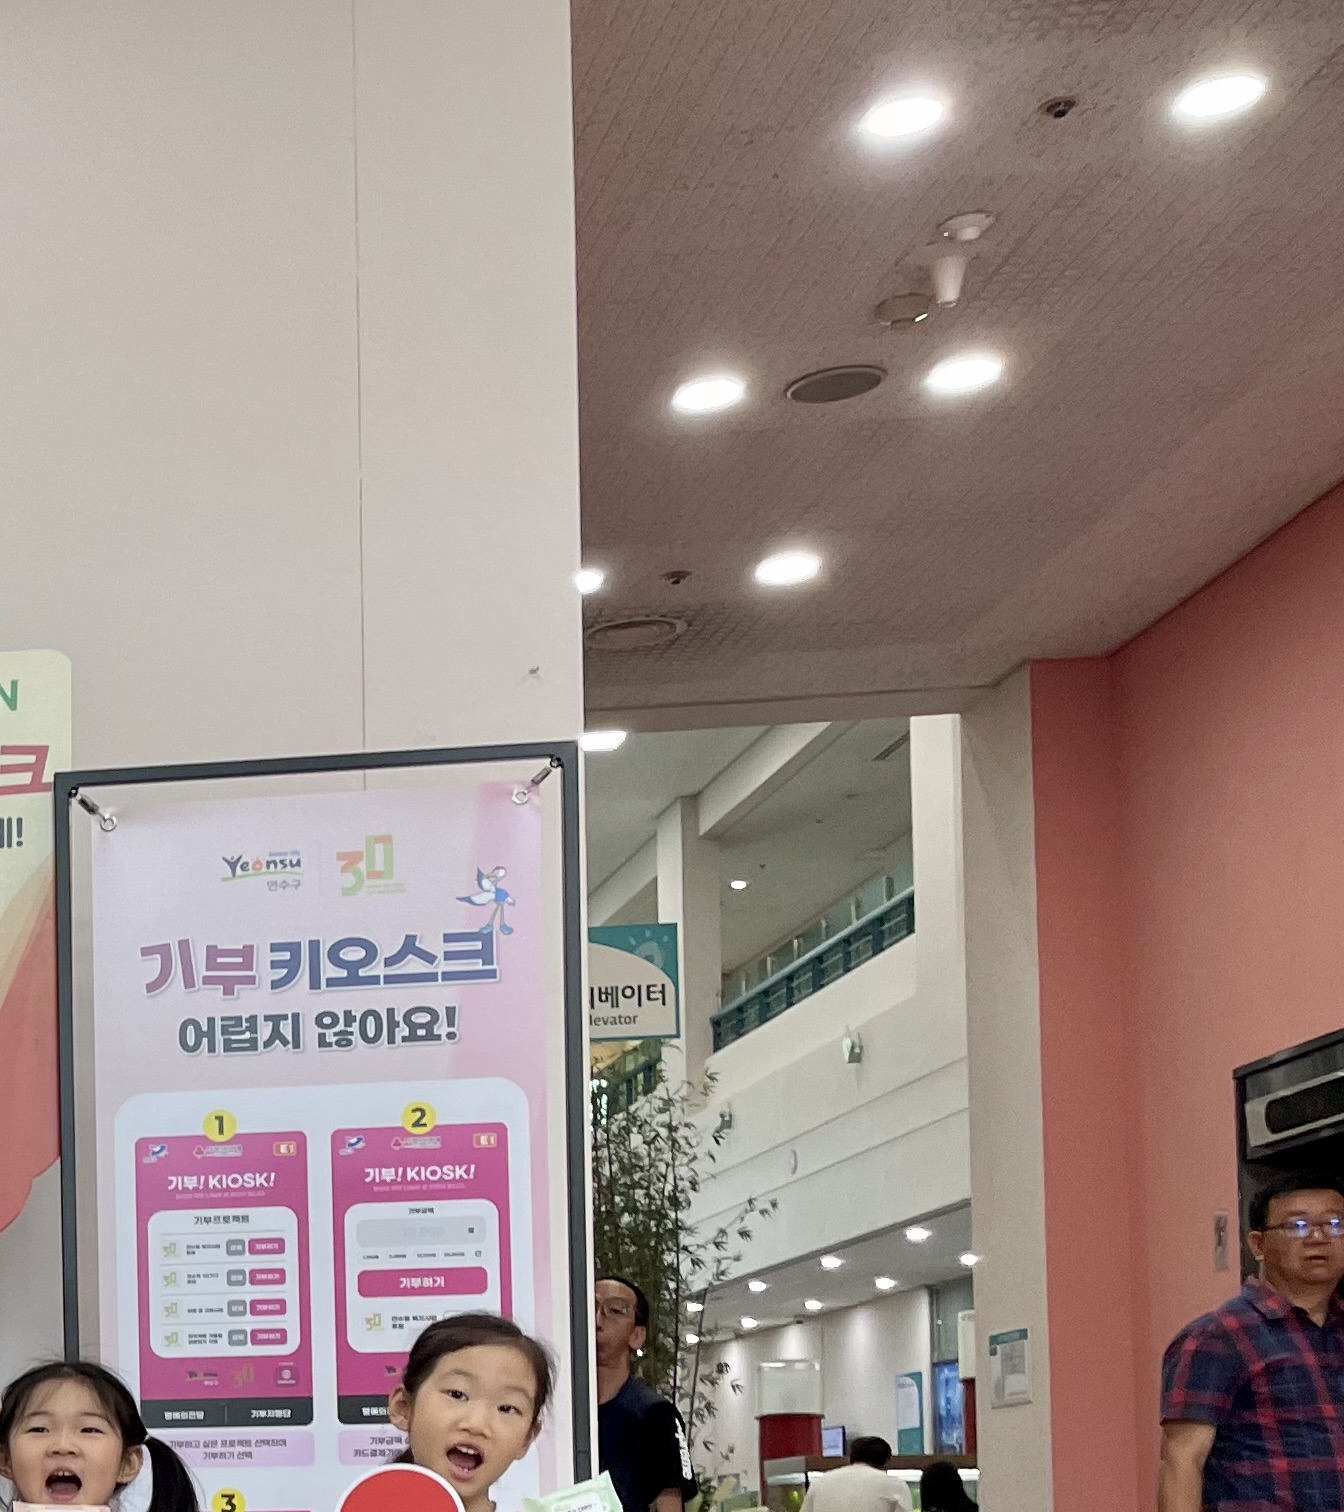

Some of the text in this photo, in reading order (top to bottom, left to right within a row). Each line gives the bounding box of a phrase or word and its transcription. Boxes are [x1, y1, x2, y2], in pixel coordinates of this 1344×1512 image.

[222, 855, 302, 878] Yeonsu
[336, 834, 394, 896] 30
[267, 879, 301, 891] 연수구
[140, 930, 499, 996] 기부 키오스크
[178, 1006, 459, 1054] 어렵지 않아요!
[214, 1115, 225, 1135] 1
[411, 1107, 428, 1128] 2
[167, 1172, 276, 1190] 기부! KIOSK!
[364, 1164, 476, 1183] 기부! KIOSK!
